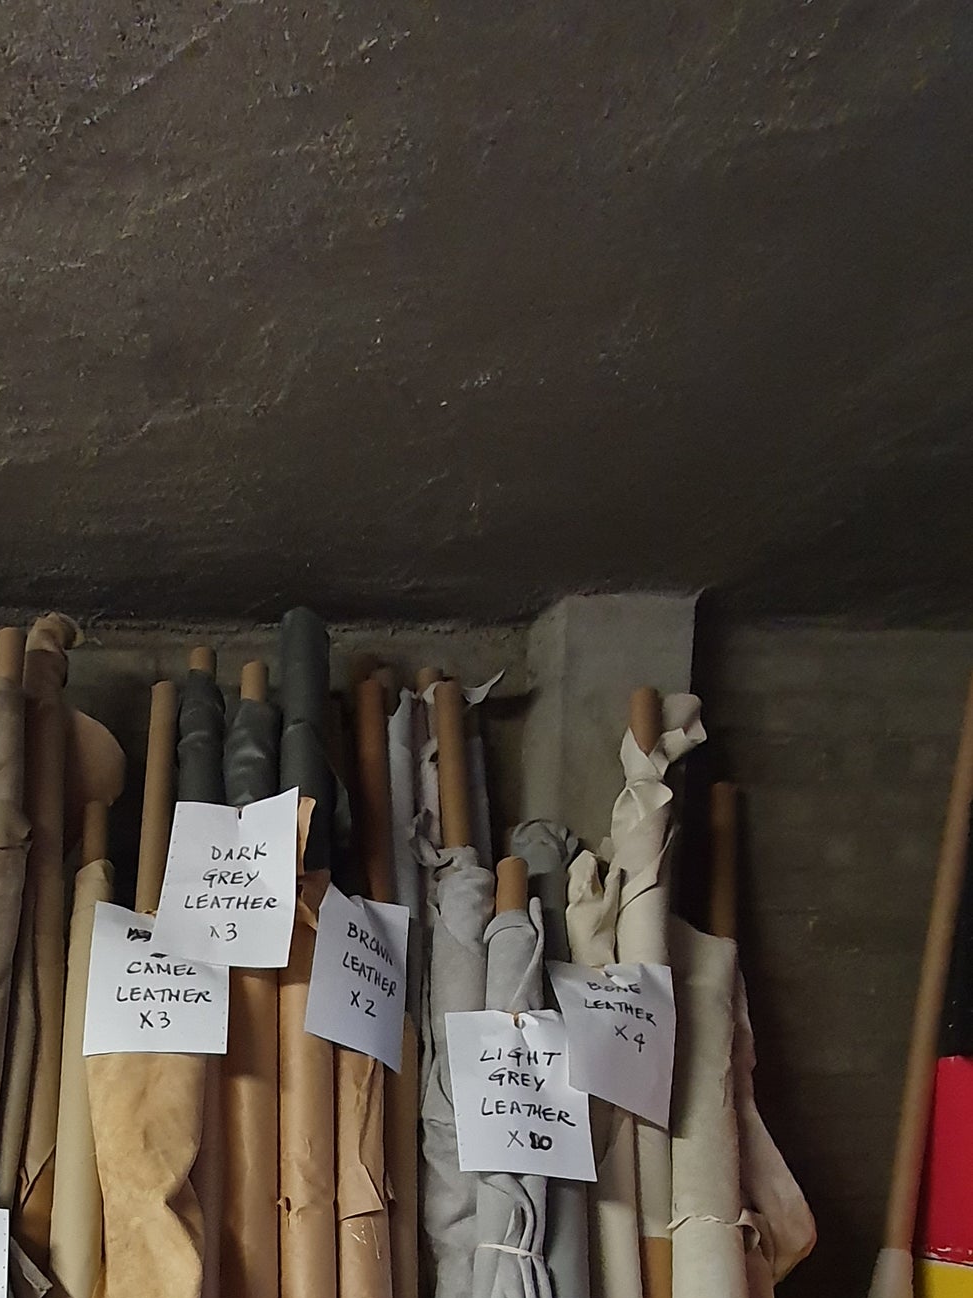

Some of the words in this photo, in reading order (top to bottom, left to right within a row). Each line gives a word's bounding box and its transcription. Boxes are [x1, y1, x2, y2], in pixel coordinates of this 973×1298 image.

[210, 842, 268, 861] DARK
[202, 869, 260, 888] GREY
[184, 894, 278, 910] LEATHER
[127, 960, 197, 976] CAMEL
[342, 951, 397, 997] LEATHER
[116, 986, 212, 1004] LEATHER
[586, 981, 641, 995] BONE
[584, 998, 657, 1027] LEATHER
[479, 1047, 562, 1067] LIGHT
[488, 1068, 546, 1092] GREY
[481, 1097, 577, 1127] LEATHER
